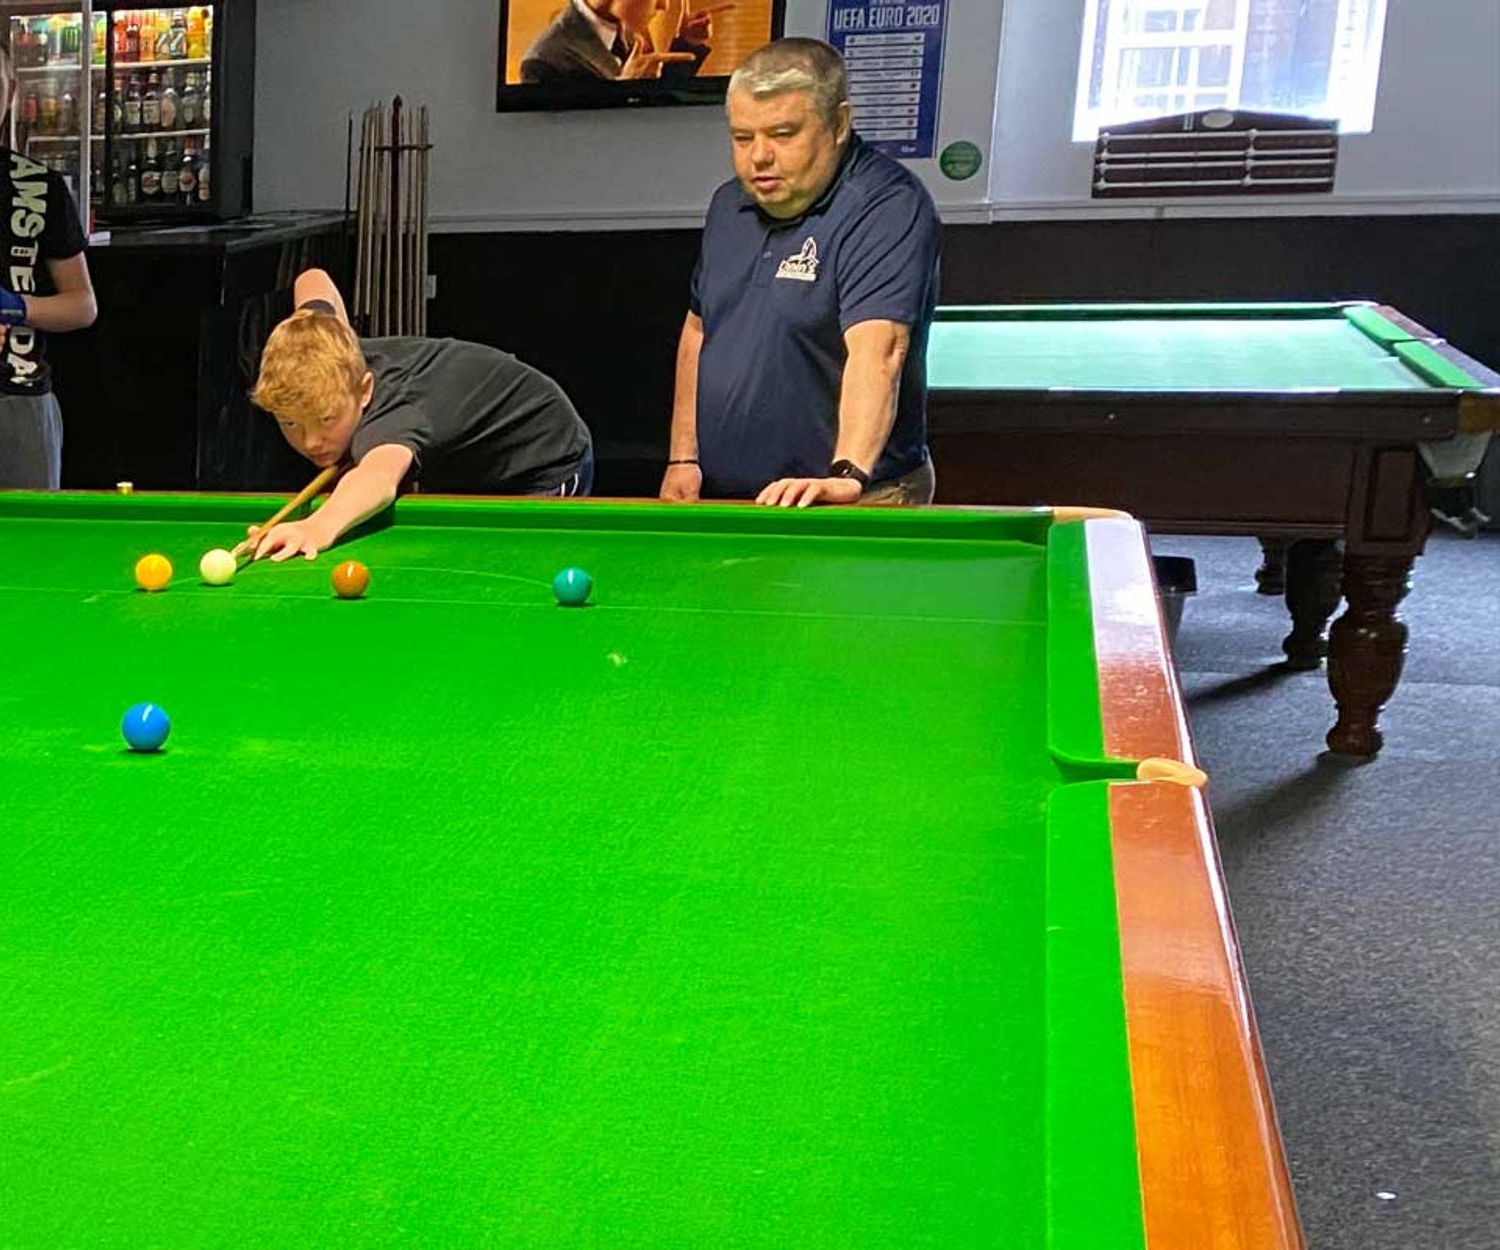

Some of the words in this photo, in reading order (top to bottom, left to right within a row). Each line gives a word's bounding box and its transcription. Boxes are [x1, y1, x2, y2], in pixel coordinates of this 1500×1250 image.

[834, 8, 865, 29] UEFA
[869, 6, 903, 27] EURO
[906, 4, 940, 26] 2020
